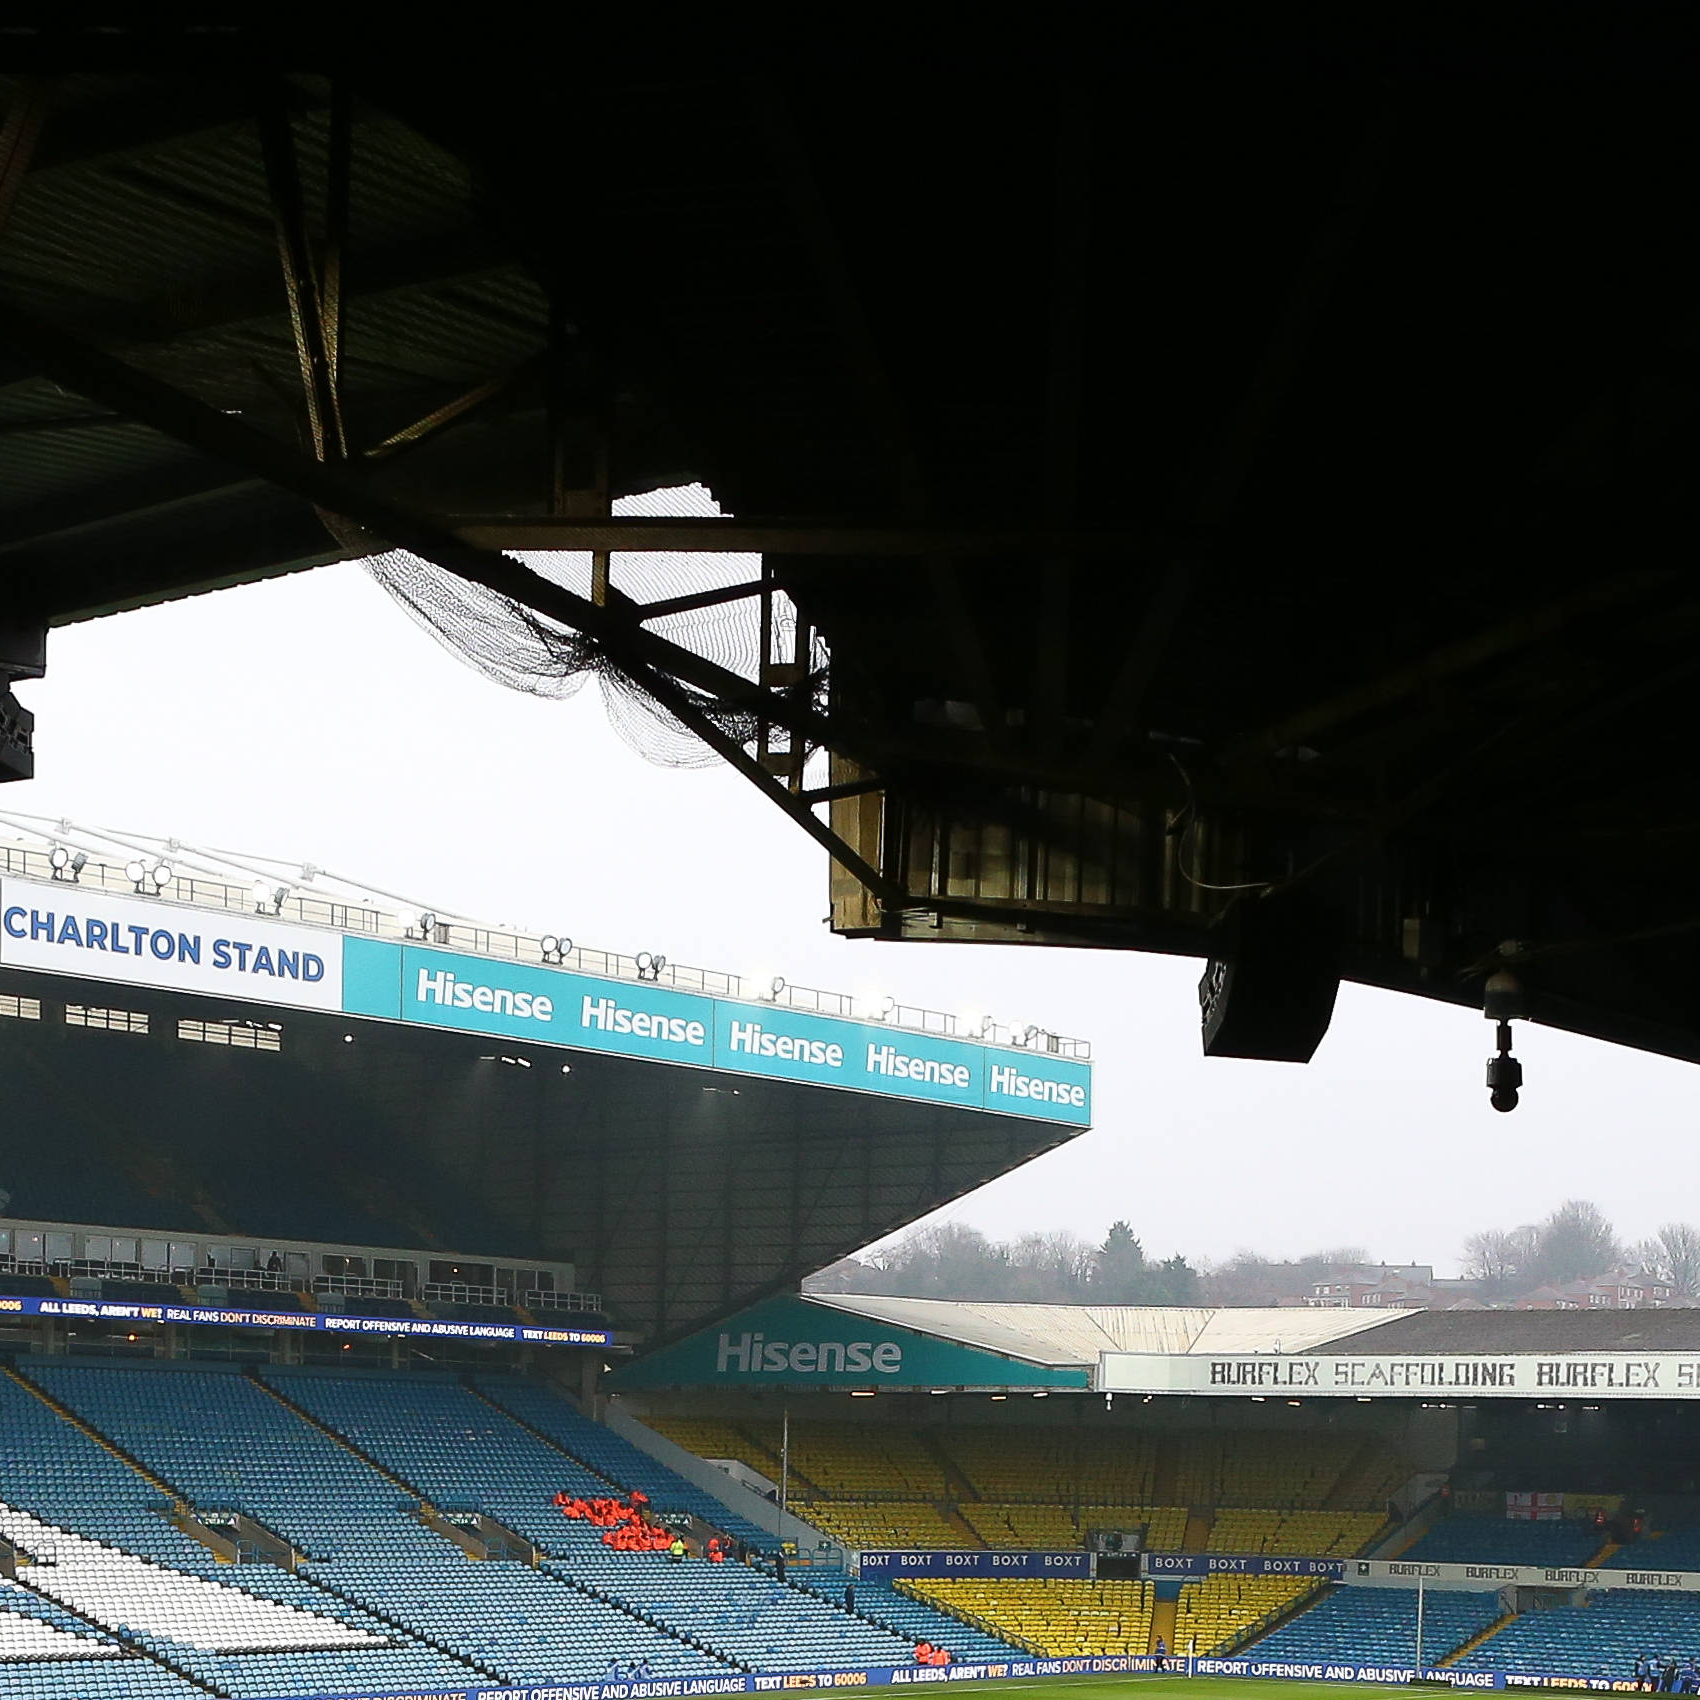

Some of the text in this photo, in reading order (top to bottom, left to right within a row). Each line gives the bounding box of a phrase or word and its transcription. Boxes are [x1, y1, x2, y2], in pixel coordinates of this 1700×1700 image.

[4, 907, 200, 964] CHARLTON
[213, 940, 324, 982] STAND
[417, 969, 553, 1021] Hisense
[582, 997, 704, 1045] Hisense
[731, 1022, 843, 1067] Hisense
[867, 1043, 969, 1088] Hisense
[990, 1066, 1085, 1106] Hisense
[40, 1302, 59, 1312] ALL
[62, 1303, 99, 1315] LEEDS,
[102, 1306, 140, 1317] AREN'T
[167, 1309, 316, 1327] REAL FANS DON'T DISCRIMINATE
[326, 1318, 514, 1338] REPORT OFFENSIVE AND ABUSIVE LANGUAGE
[717, 1333, 901, 1372] Hisense
[1210, 1362, 1319, 1386] BURFLEX
[1334, 1362, 1515, 1386] SCAFFOLDING
[1536, 1362, 1659, 1388] BURFLEX
[863, 1555, 890, 1565] BOXT
[901, 1555, 932, 1565] BOXT
[946, 1555, 980, 1566] BOXT
[993, 1555, 1028, 1566] BOXT
[1044, 1556, 1082, 1566] BOXT
[1155, 1558, 1193, 1568] BOXT
[1209, 1559, 1247, 1570] BOXT
[1264, 1560, 1300, 1571] BOXT
[1309, 1562, 1343, 1572] BOXT
[892, 1665, 1008, 1684] ALL LEEDS, AREN'T WE?
[1012, 1660, 1090, 1676] REAL FANS DON'T
[1198, 1661, 1413, 1683] REPORT OFFENSIVE AND ABUSIVE
[602, 1684, 628, 1699] AND
[630, 1681, 681, 1698] ABUSIVE
[683, 1678, 745, 1695] LANGUAGE
[754, 1672, 867, 1691] TEXT TO 60006
